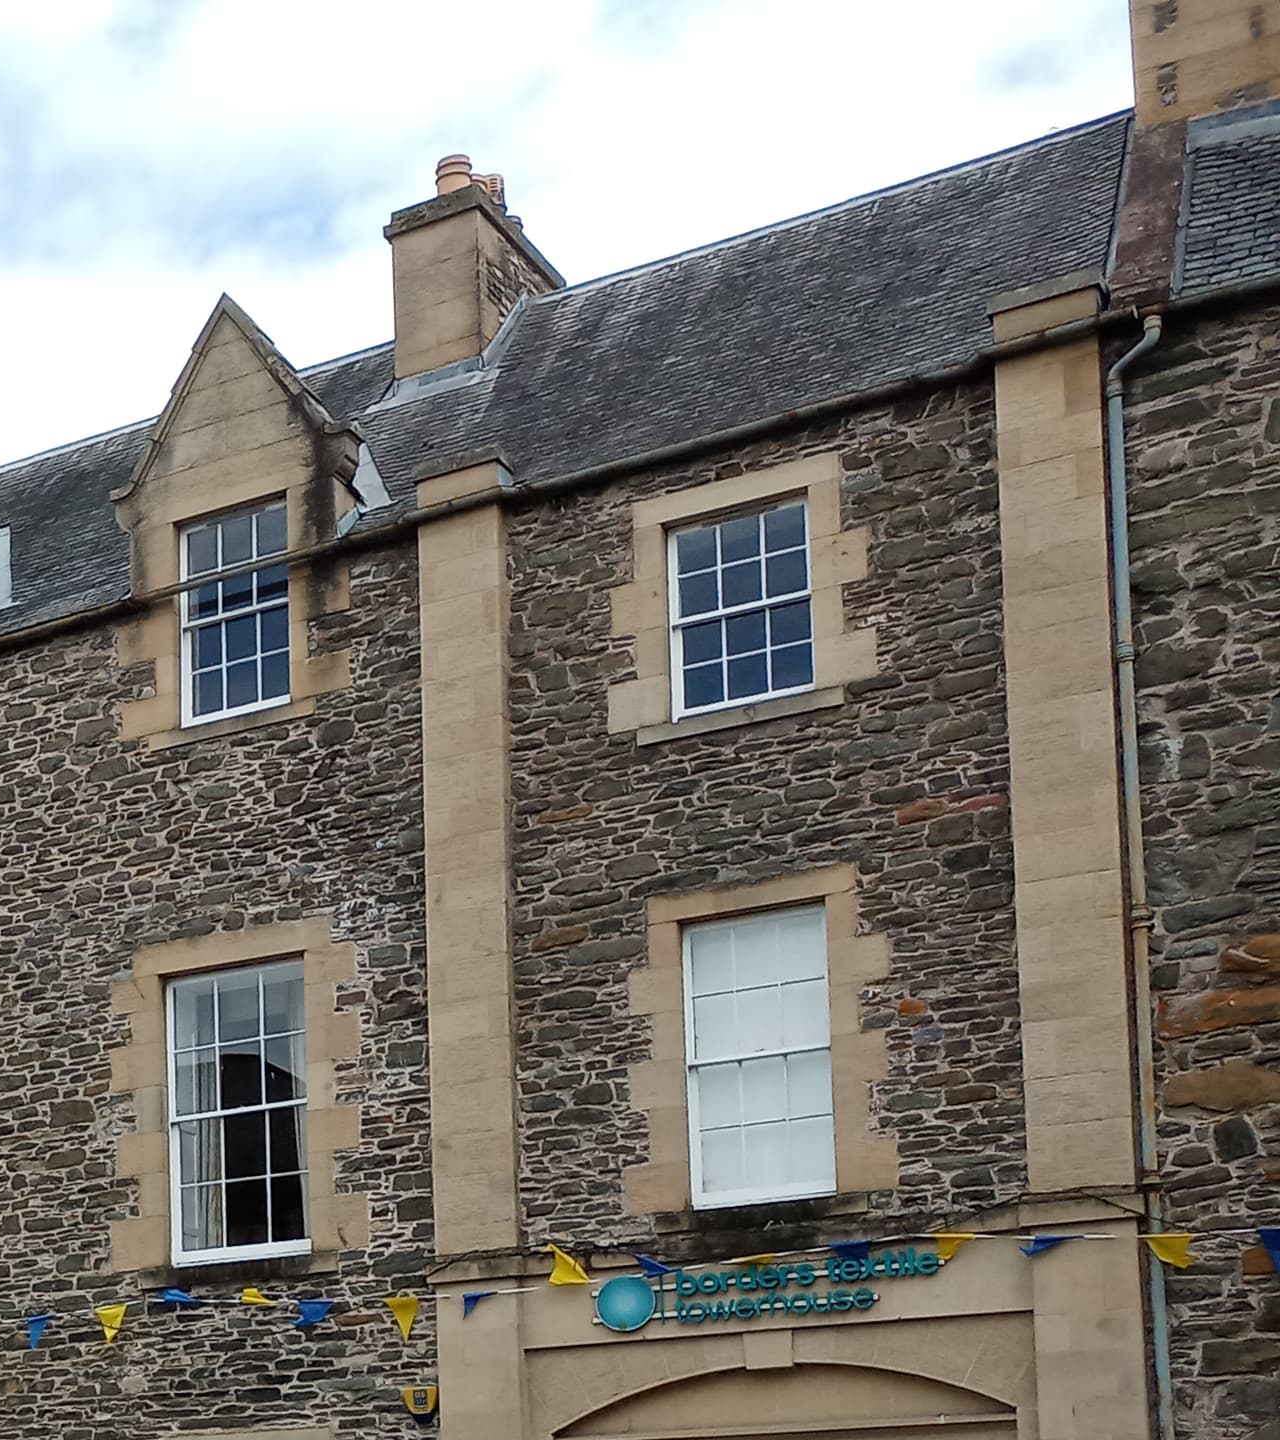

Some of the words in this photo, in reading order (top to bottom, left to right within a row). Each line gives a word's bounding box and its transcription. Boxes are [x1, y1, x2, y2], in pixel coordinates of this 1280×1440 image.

[676, 1264, 817, 1297] borders
[826, 1248, 941, 1282] textile
[675, 1287, 876, 1324] towerhouse
